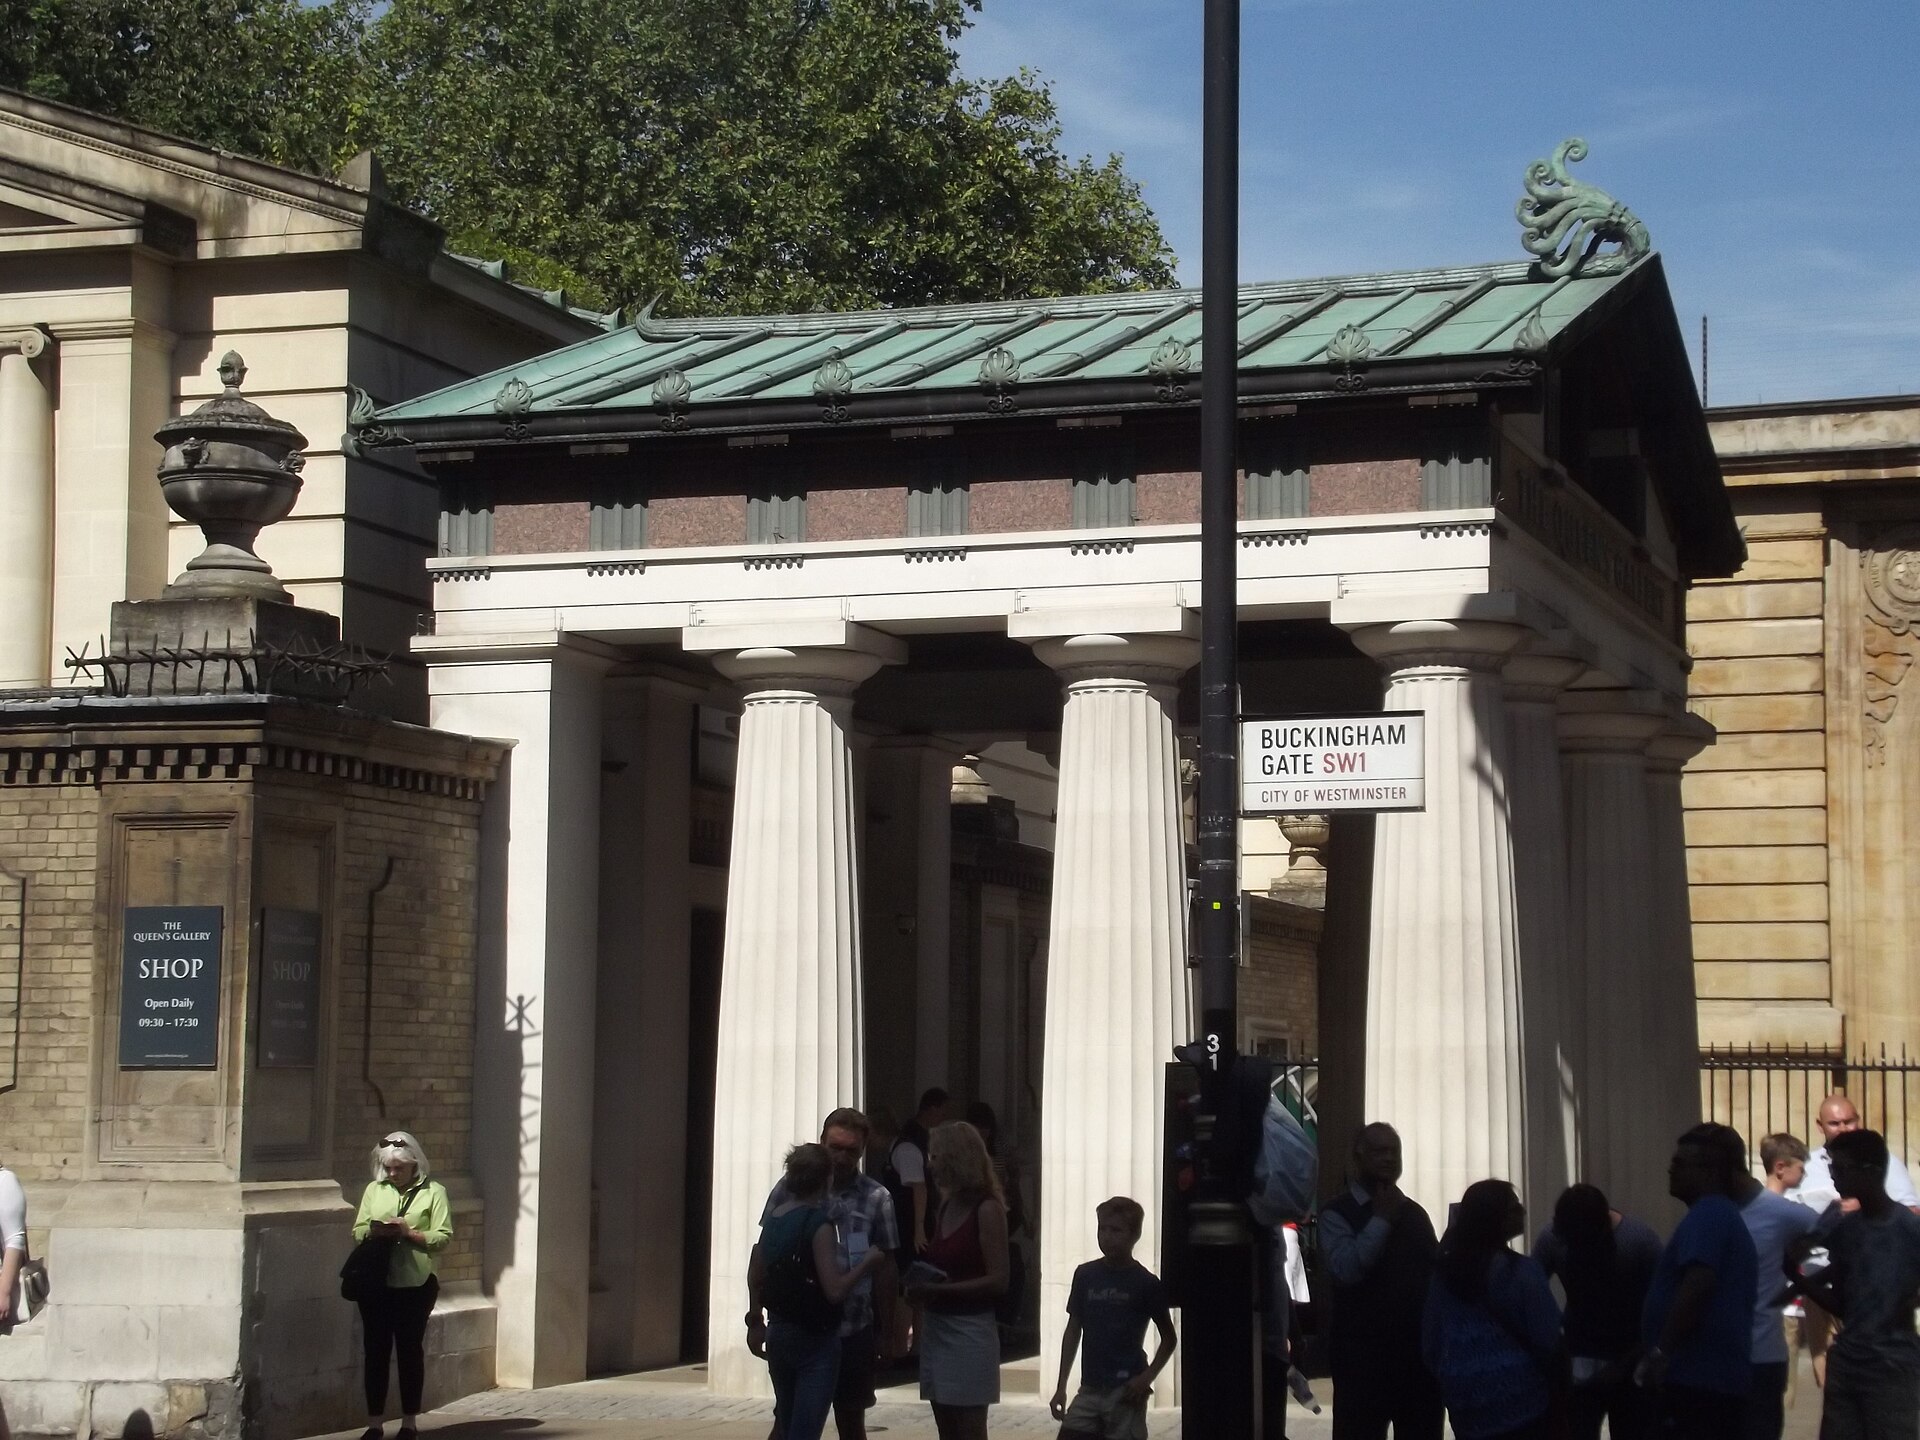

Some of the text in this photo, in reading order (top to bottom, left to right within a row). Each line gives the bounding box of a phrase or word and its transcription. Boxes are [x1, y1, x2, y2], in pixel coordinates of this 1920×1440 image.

[1261, 724, 1406, 749] BUCKINGHAM
[1261, 752, 1366, 776] GATE SW1
[1261, 786, 1407, 803] CITY OF WESTMINSTER
[162, 921, 182, 931] THE
[133, 932, 211, 943] QUEEN'S GALLERY
[139, 958, 204, 979] SHOP
[272, 960, 311, 982] SHOP
[144, 997, 195, 1010] Open Daily
[138, 1018, 164, 1027] 09:30
[174, 1017, 199, 1027] 17:30
